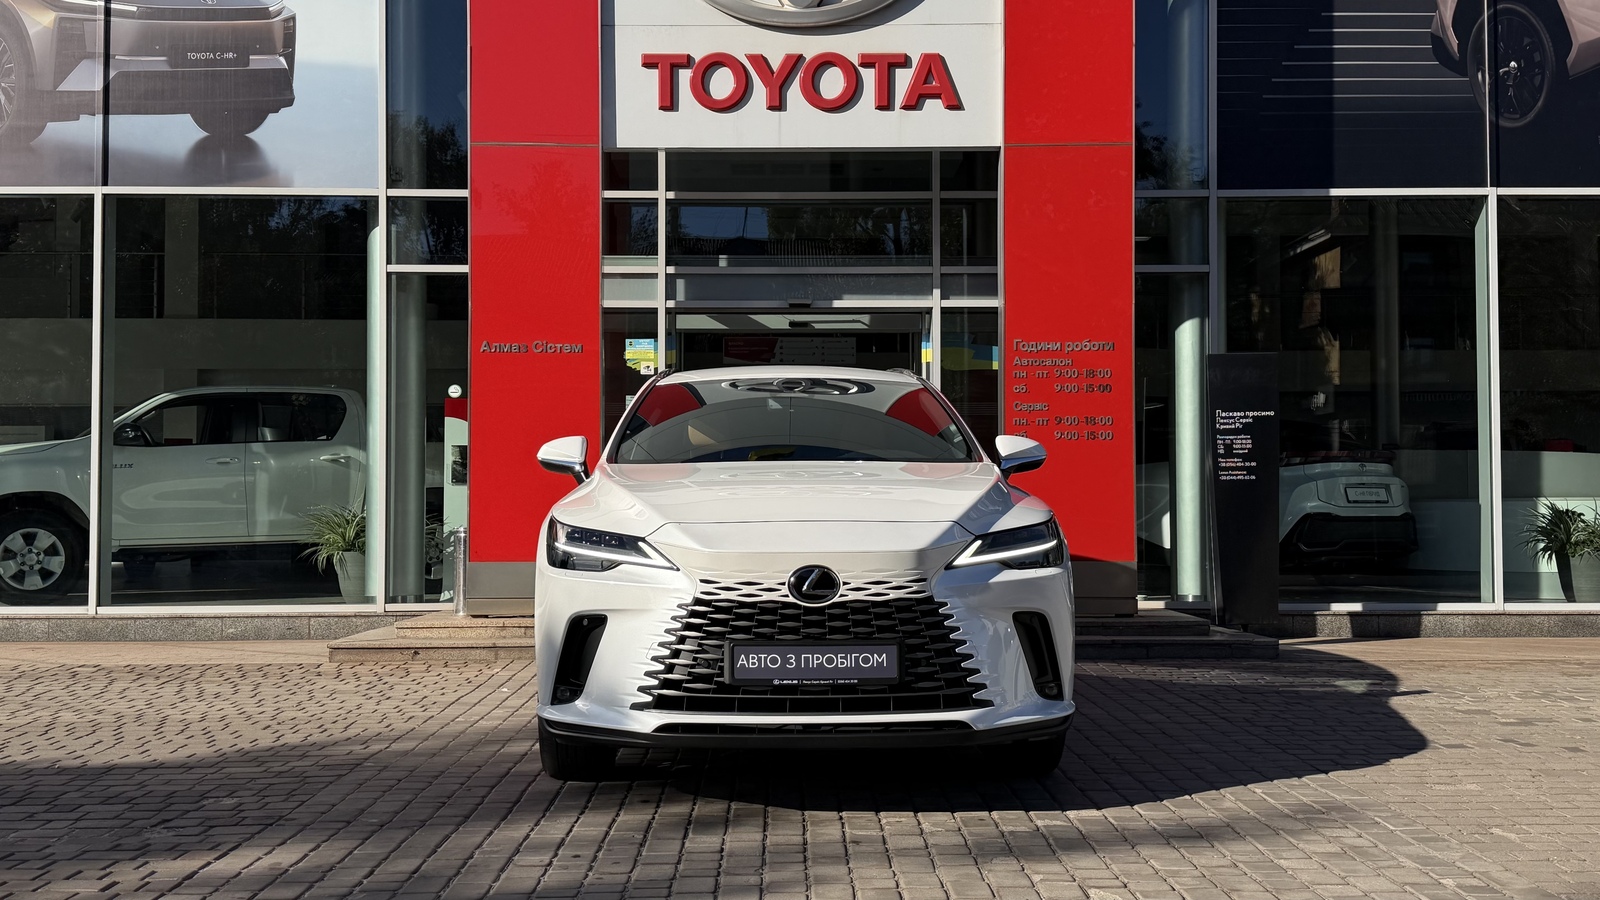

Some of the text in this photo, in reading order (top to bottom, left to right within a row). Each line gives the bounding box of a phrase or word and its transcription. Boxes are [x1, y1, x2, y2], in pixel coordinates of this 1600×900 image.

[187, 52, 214, 60] TOYOTA
[641, 51, 963, 112] TOYOTA
[480, 340, 584, 353] Алмаз Сістем
[1013, 339, 1115, 353] Години роботи
[1013, 356, 1073, 366] Автосалон
[1013, 401, 1050, 413] Сервіс
[736, 653, 887, 668] АВТО З ПРОБІГОМ
